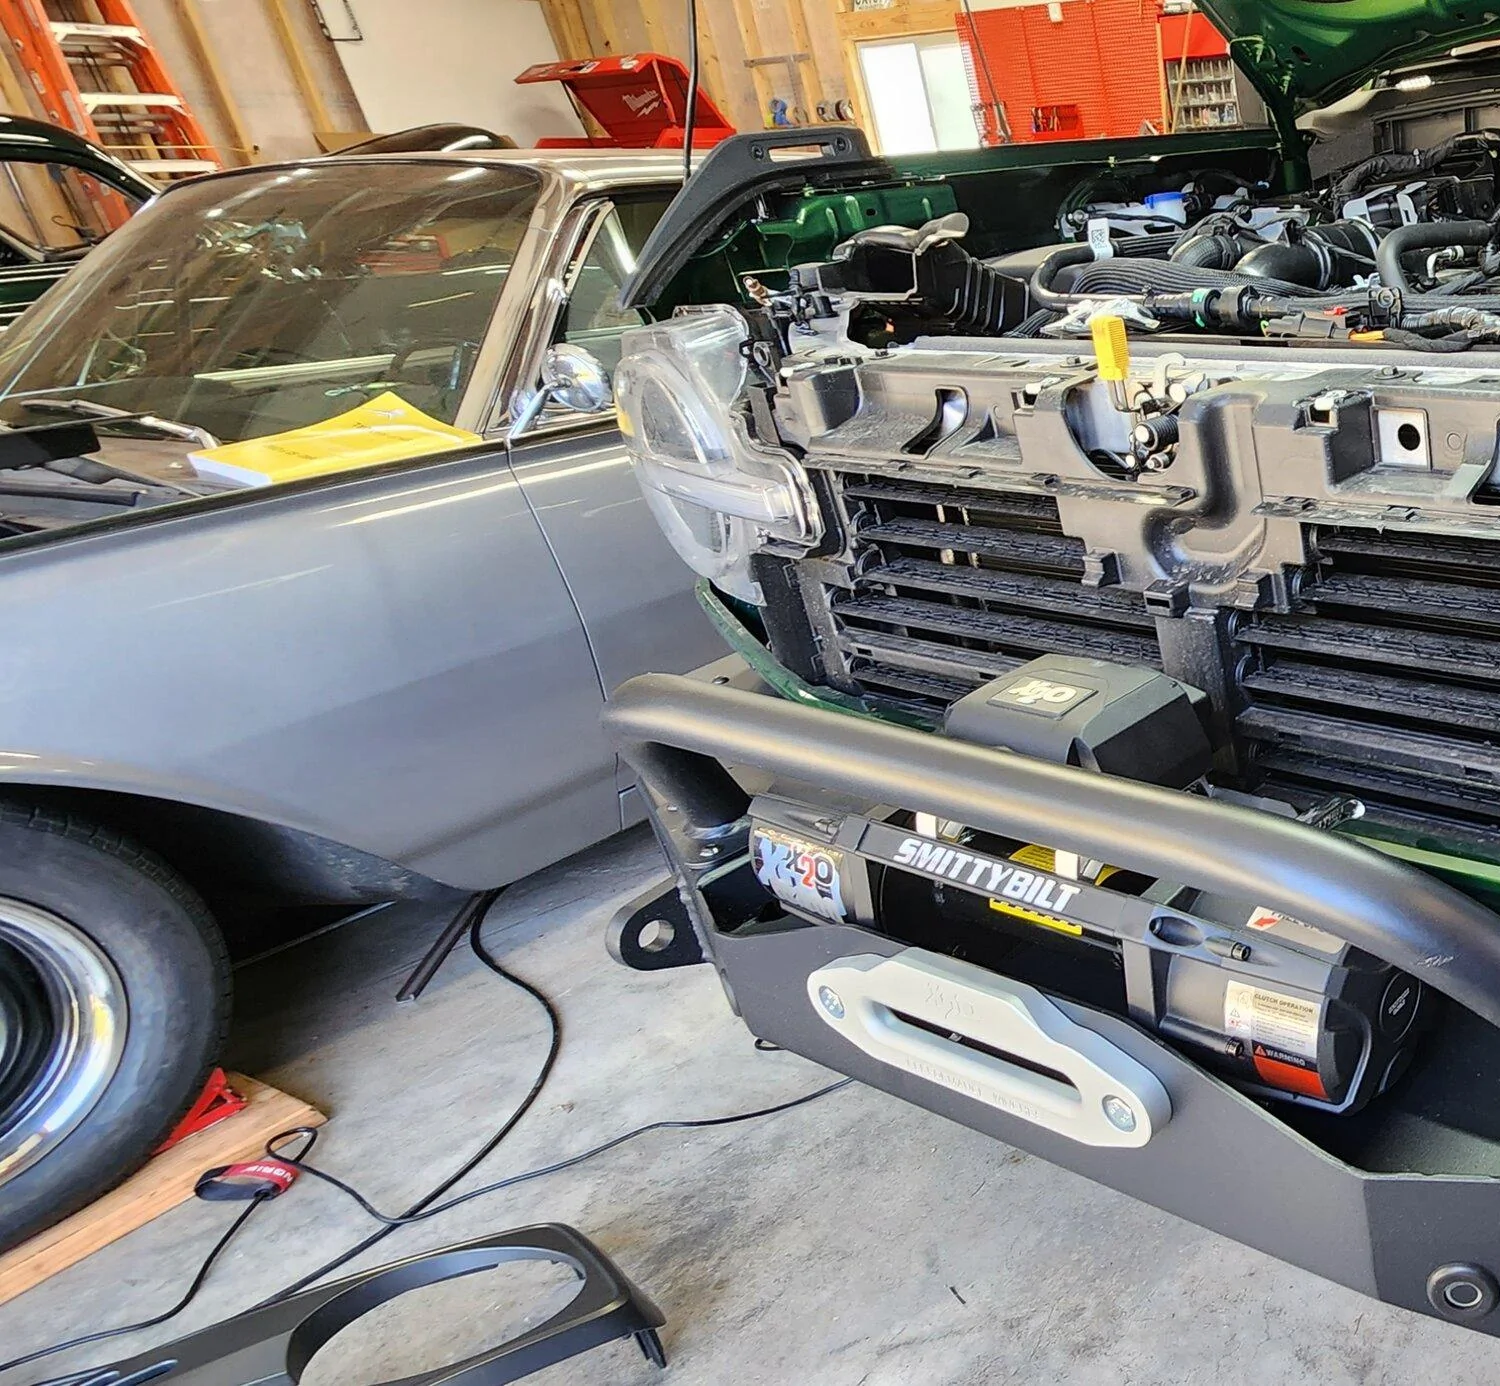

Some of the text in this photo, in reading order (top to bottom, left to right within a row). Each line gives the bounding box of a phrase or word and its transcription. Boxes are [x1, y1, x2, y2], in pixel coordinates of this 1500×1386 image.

[893, 837, 1081, 912] SMITTYBILT
[1254, 993, 1314, 1014] CLUTCH OPERATION
[1265, 1047, 1306, 1067] WARNING
